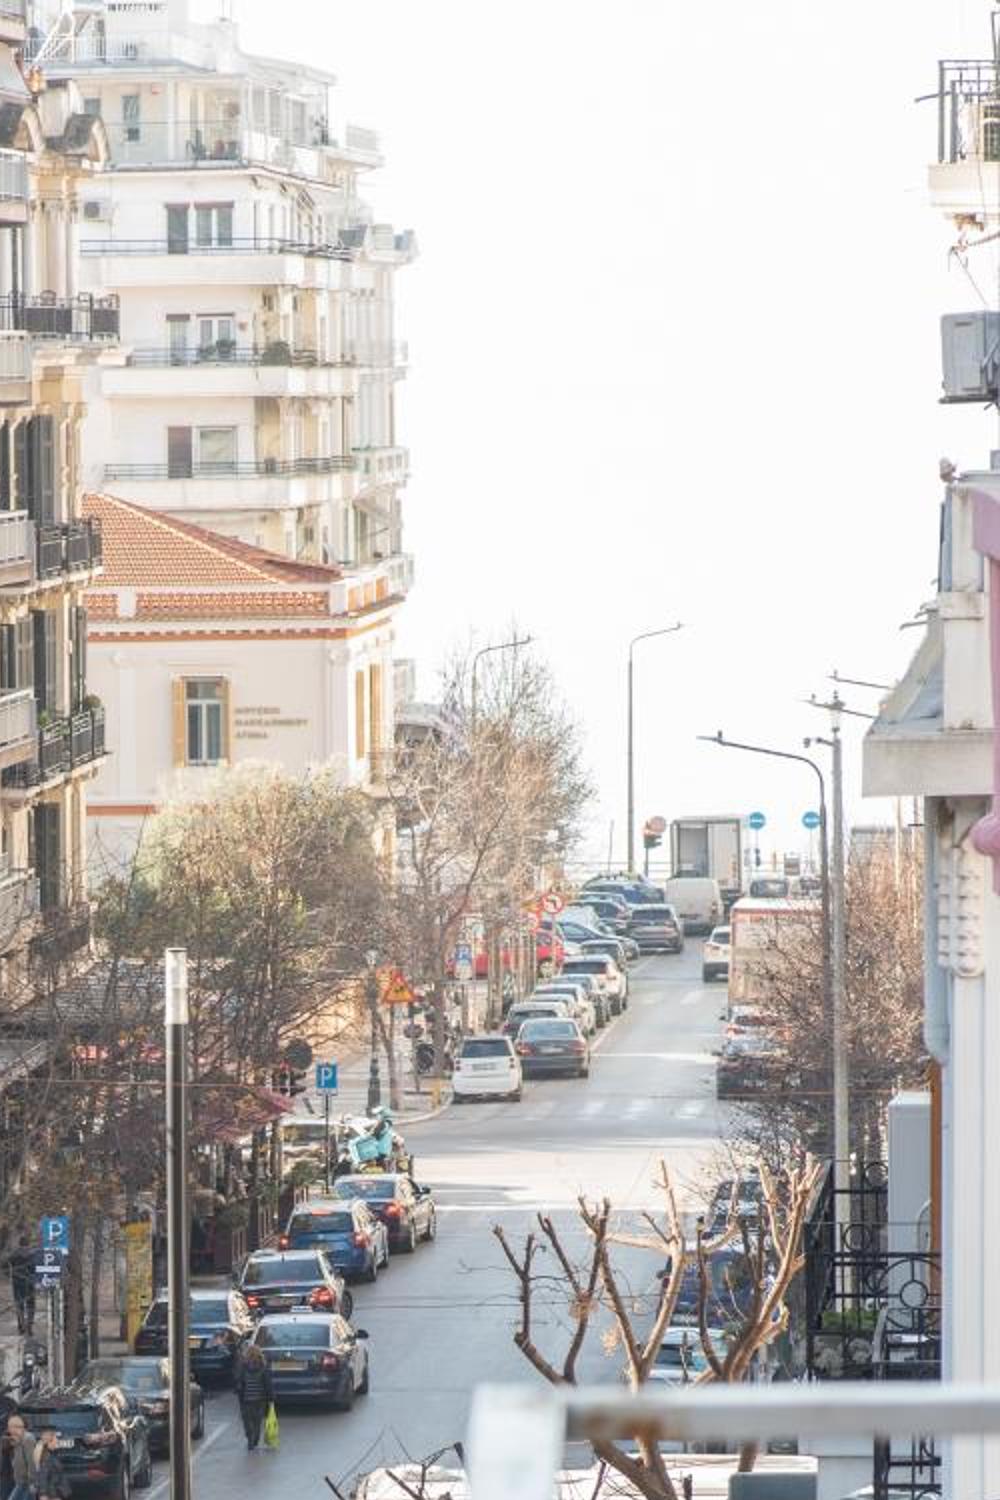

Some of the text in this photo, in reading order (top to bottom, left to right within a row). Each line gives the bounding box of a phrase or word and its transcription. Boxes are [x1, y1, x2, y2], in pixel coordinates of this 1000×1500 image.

[321, 1067, 333, 1087] P
[49, 1221, 63, 1241] P
[44, 1253, 55, 1266] P
